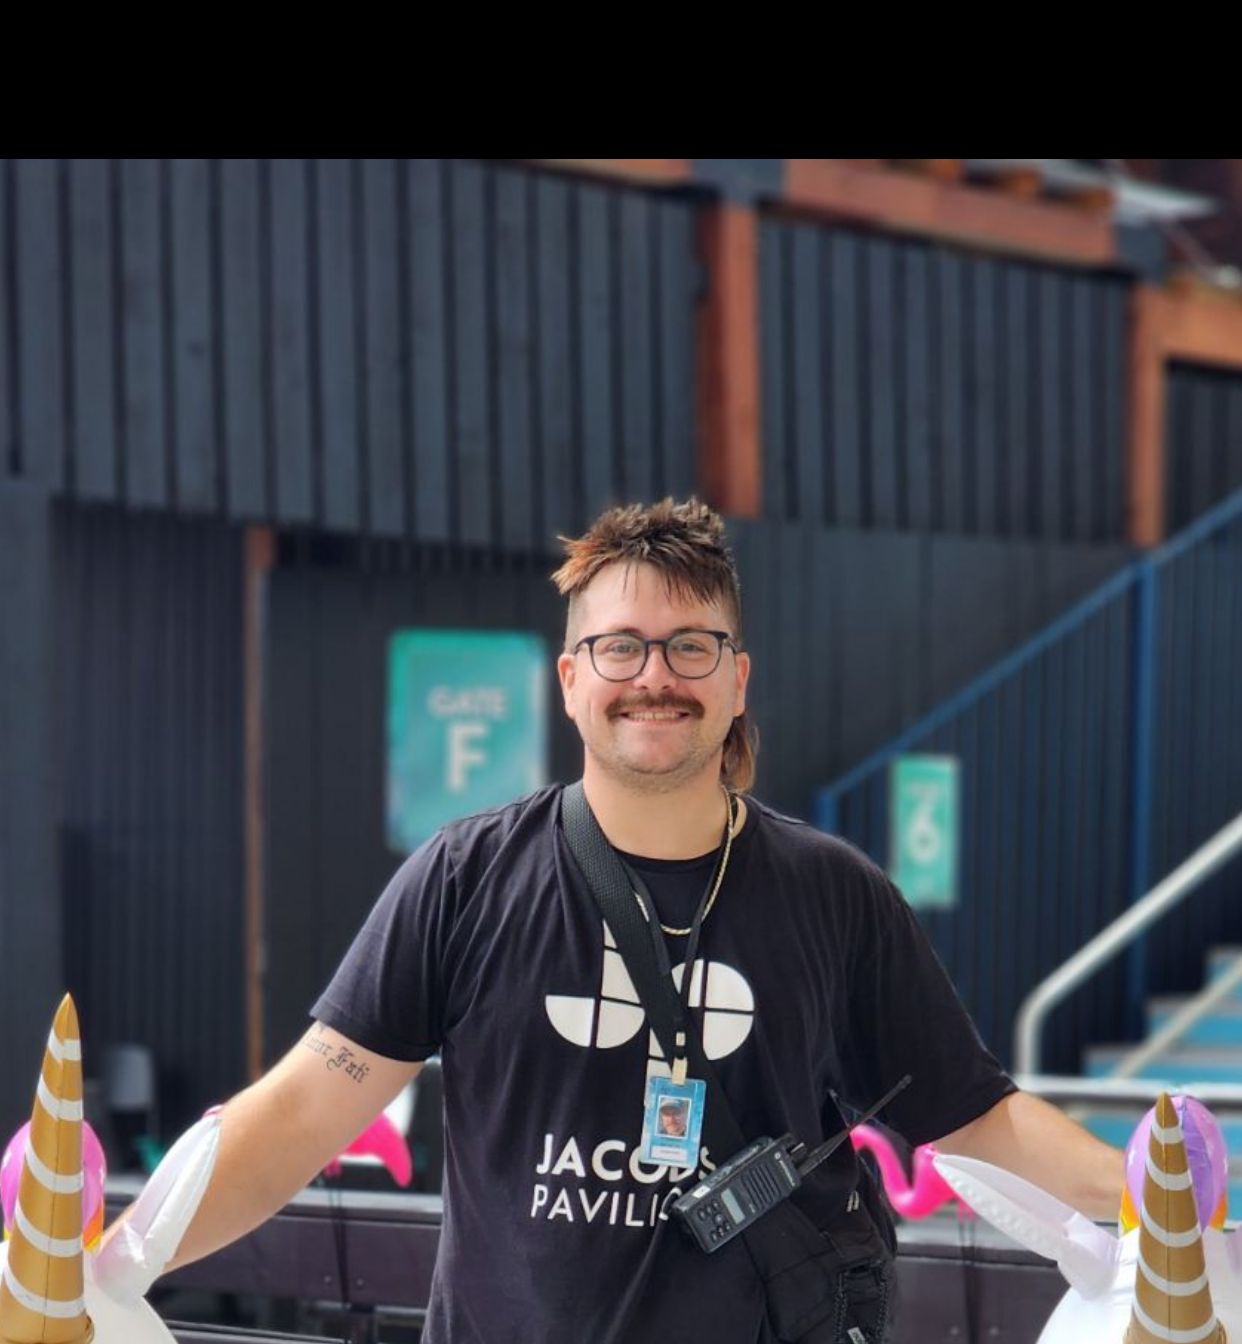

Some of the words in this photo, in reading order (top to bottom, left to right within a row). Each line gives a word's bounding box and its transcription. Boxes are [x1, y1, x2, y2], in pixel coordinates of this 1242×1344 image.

[428, 686, 506, 716] GATE
[446, 721, 489, 792] F
[907, 798, 941, 865] 6
